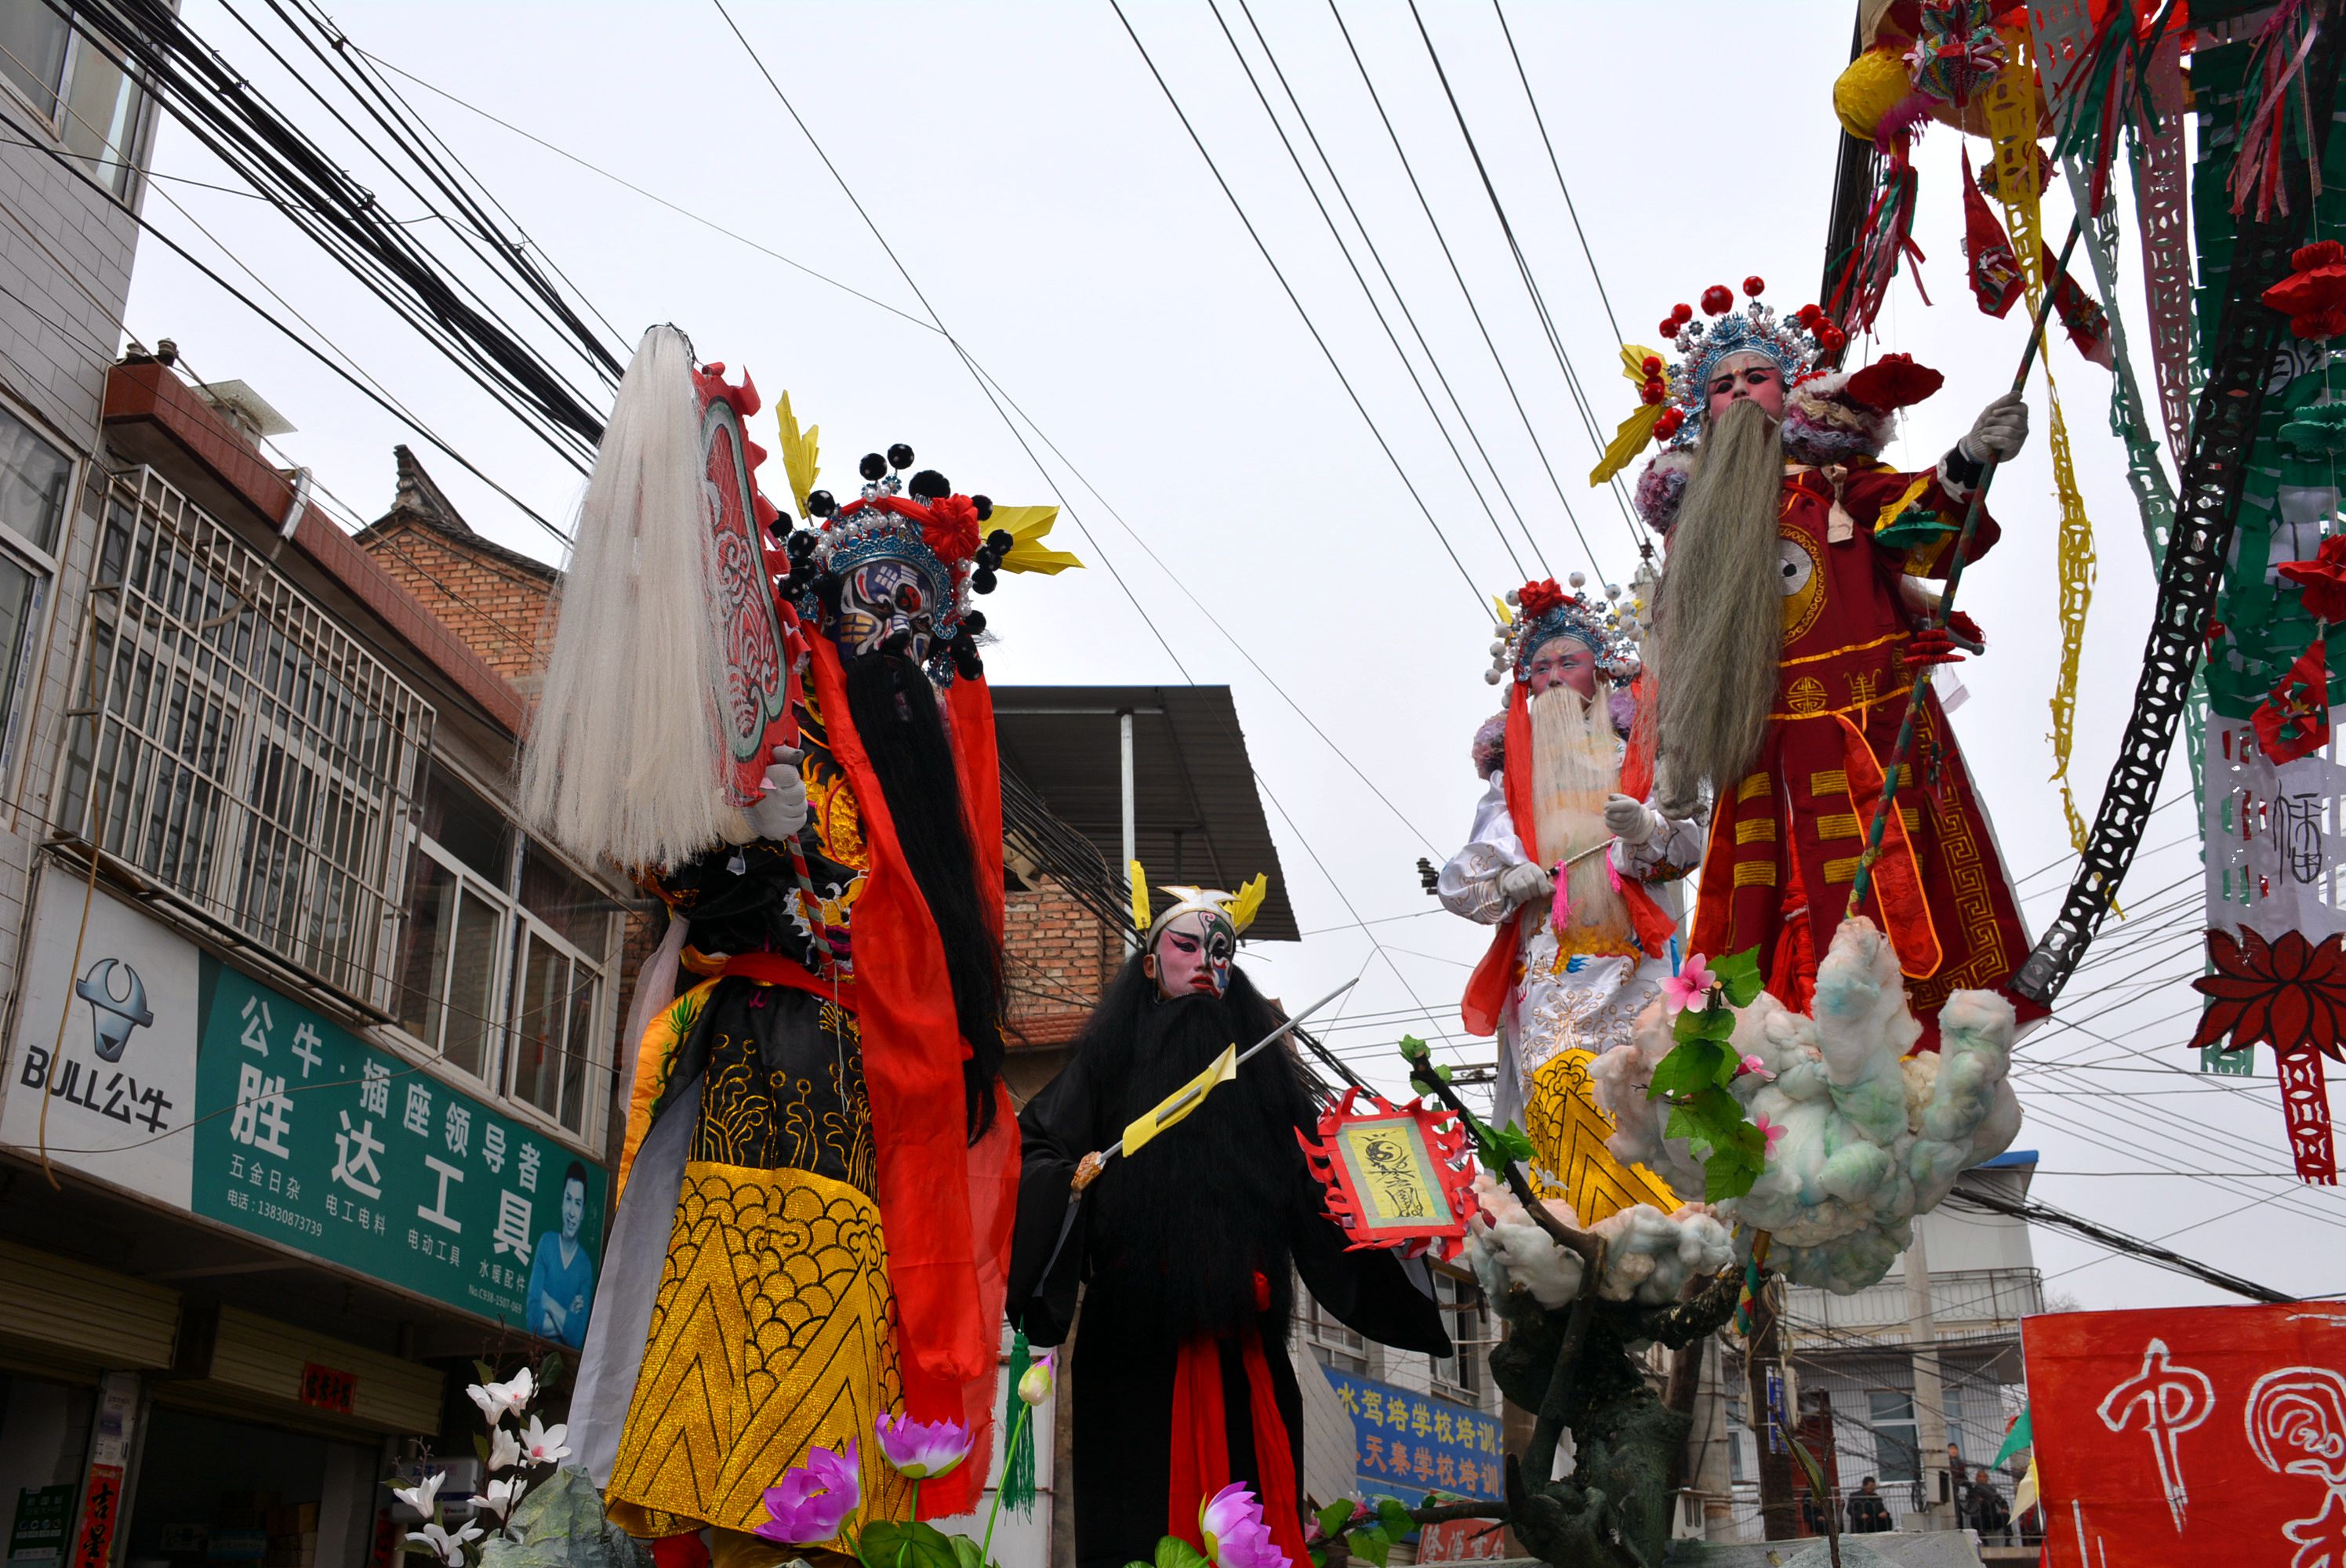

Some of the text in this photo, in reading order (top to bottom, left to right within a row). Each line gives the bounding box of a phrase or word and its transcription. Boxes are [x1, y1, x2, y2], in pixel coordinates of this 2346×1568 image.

[230, 1062, 533, 1266] 胜达工具
[229, 1153, 526, 1294] 五金日杂 电工电料 电动工具 水暖配件
[1337, 1381, 1504, 1456] 水驾培学校培训
[1356, 1434, 1500, 1498] 天秦学校培训
[82, 1482, 114, 1568] 吉星
